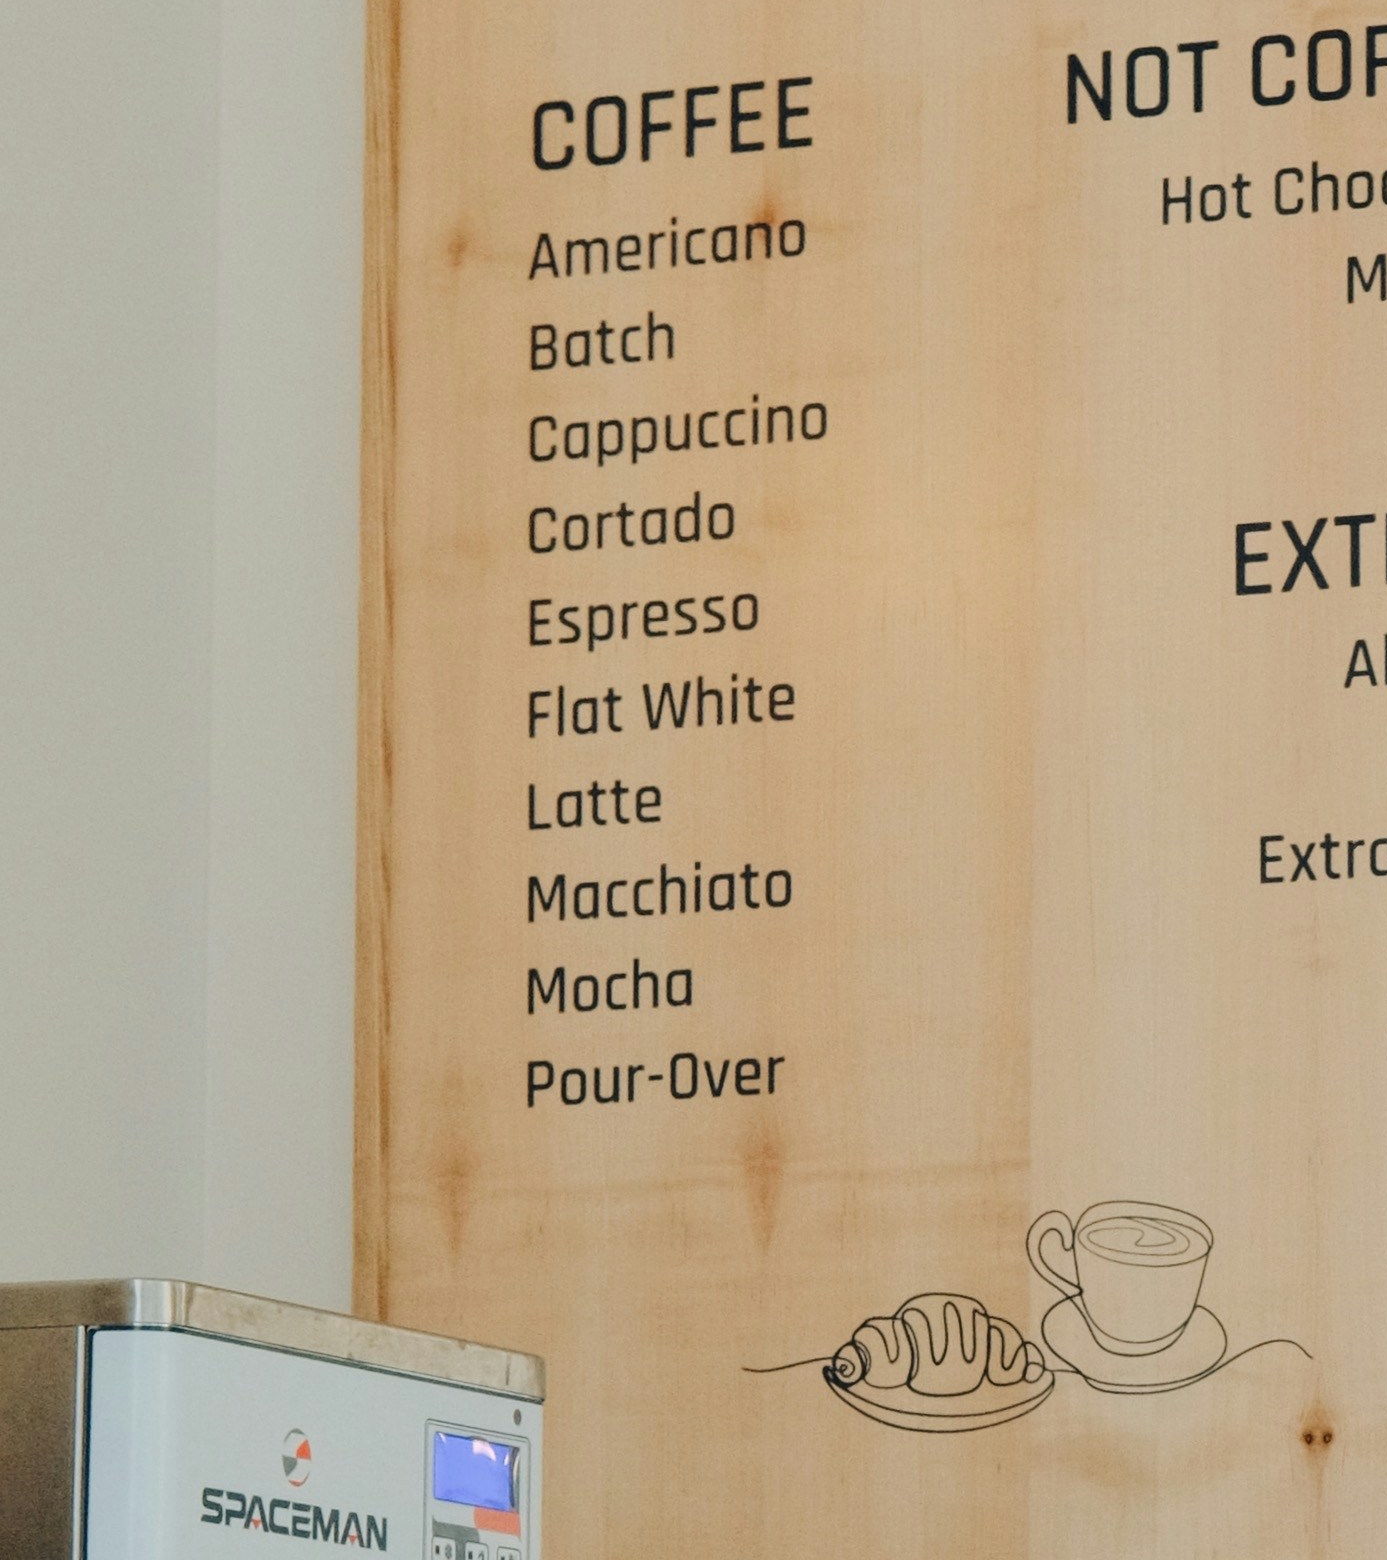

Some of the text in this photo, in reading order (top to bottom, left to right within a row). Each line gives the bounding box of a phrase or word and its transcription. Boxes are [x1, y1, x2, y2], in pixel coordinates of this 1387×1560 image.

[1066, 39, 1220, 125] NOT
[532, 76, 813, 172] COFFEE
[1162, 173, 1252, 226] Hot
[528, 216, 806, 281] Americano
[529, 310, 675, 372] Batch
[528, 393, 828, 468] Cappuccino
[528, 490, 735, 555] Cortado
[528, 593, 759, 653] Espresso
[528, 672, 795, 739] Flat White
[527, 779, 662, 831] Latte
[527, 861, 792, 924] Macchiato
[527, 957, 693, 1016] Mocha
[526, 1052, 786, 1109] Pour-Over
[200, 1487, 388, 1552] SPACEMAN
